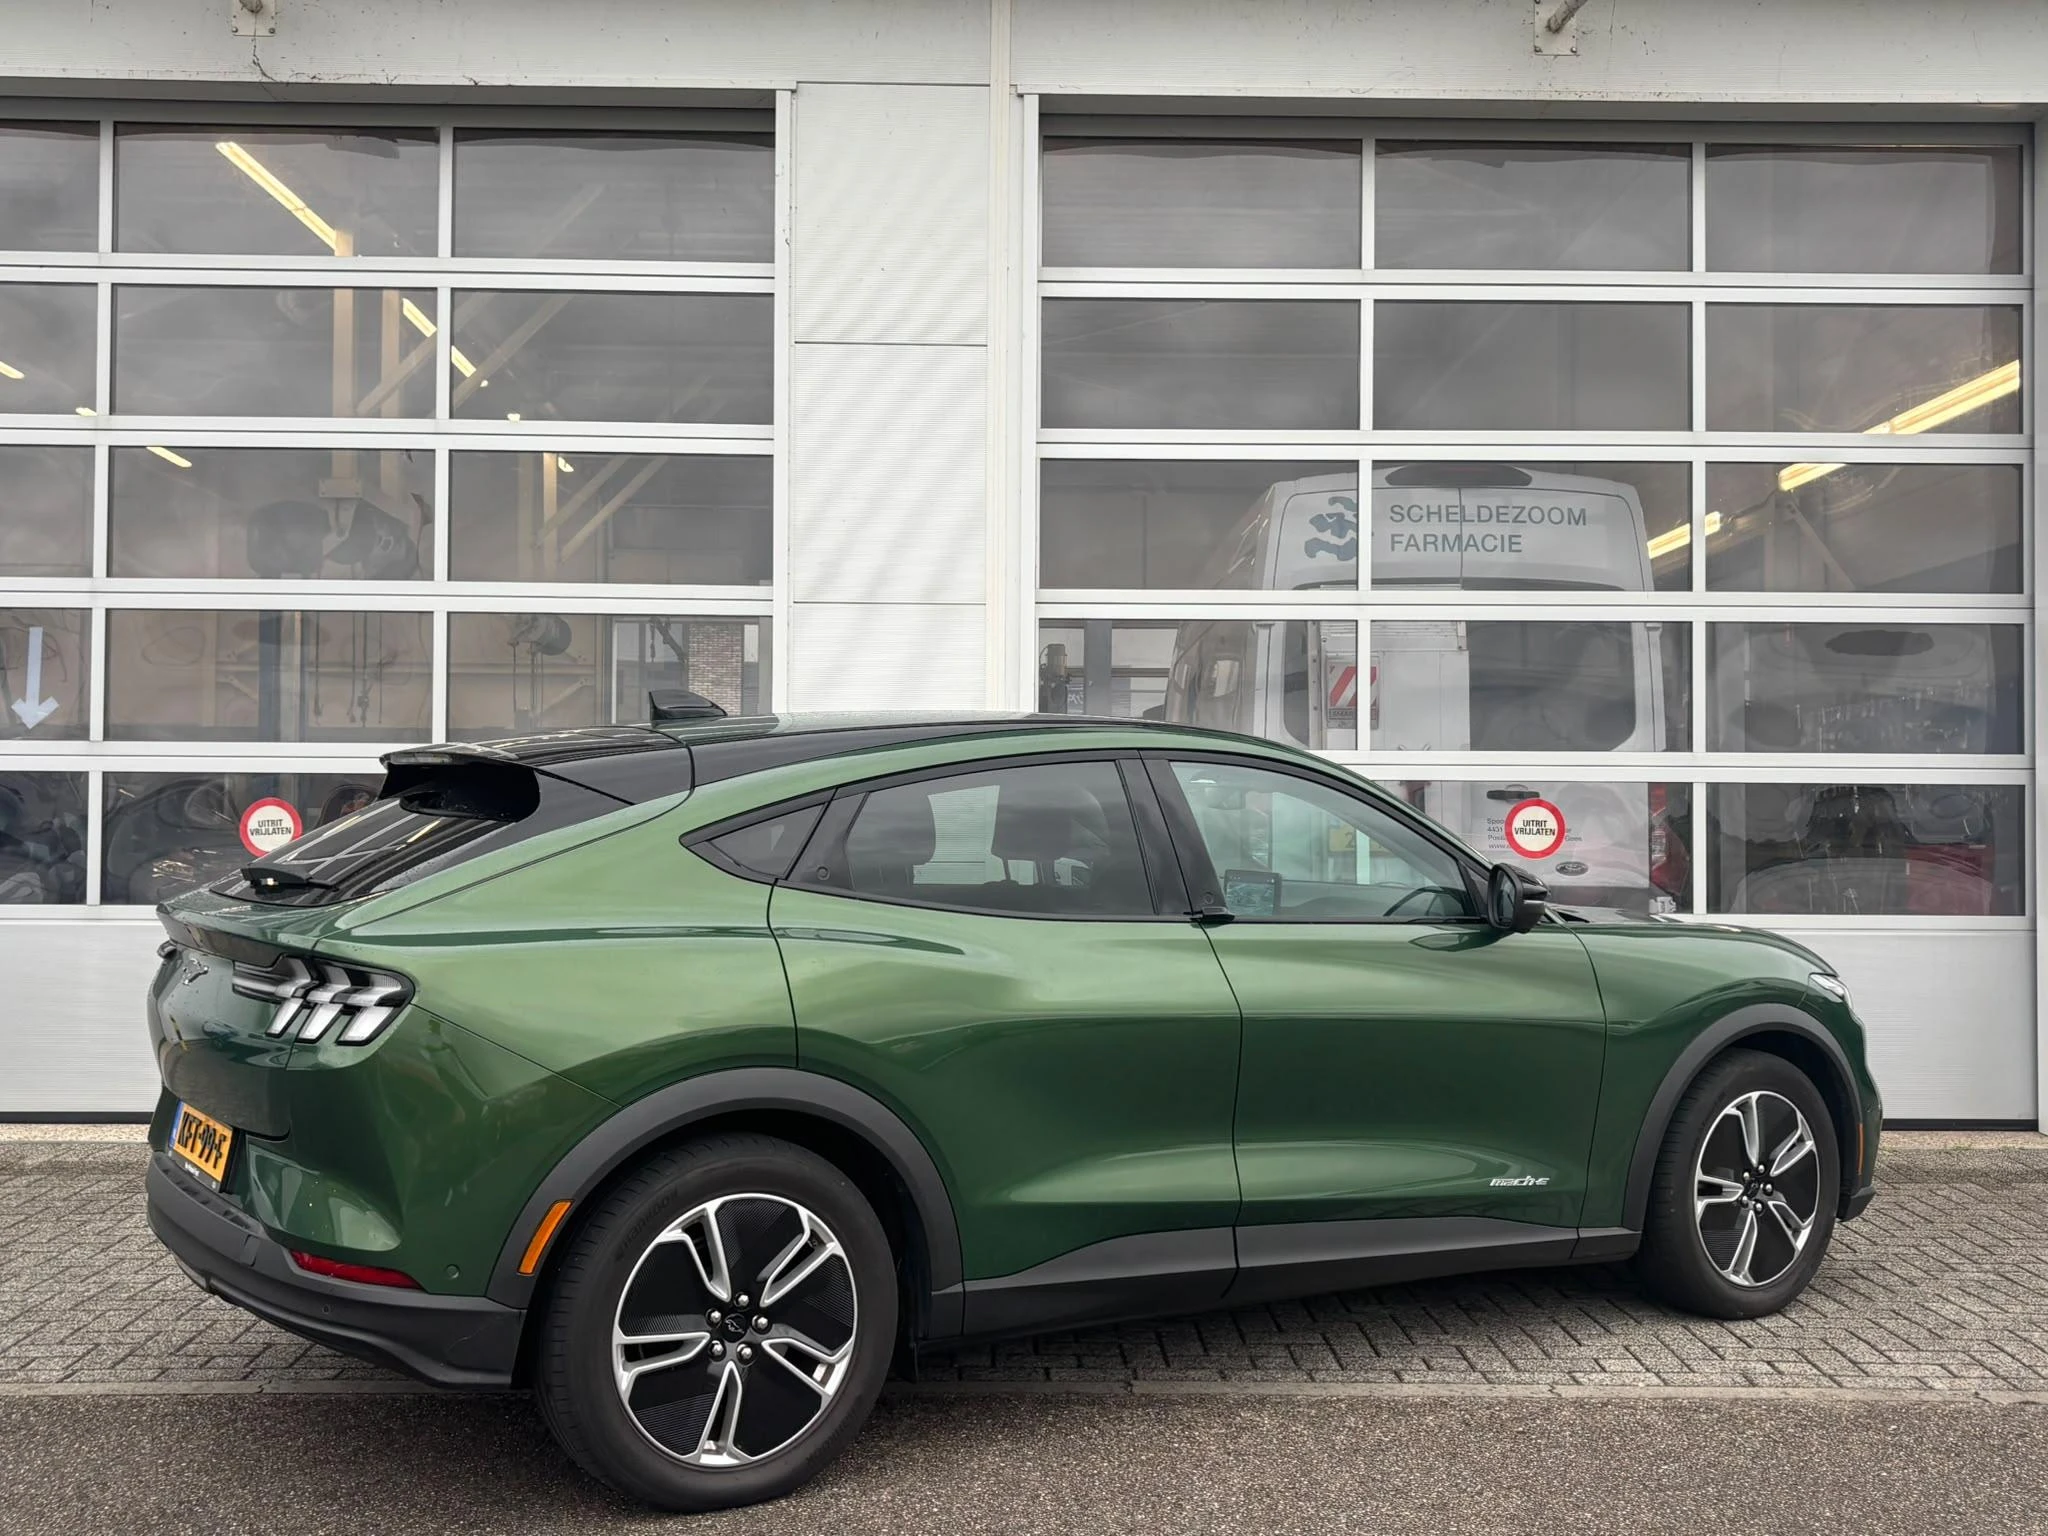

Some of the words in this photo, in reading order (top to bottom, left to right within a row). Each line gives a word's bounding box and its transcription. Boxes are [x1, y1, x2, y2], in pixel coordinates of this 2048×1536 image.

[1389, 504, 1587, 527] SCHELDEZOOM
[1390, 533, 1523, 553] FARMACIE
[257, 818, 284, 828] UITRIT
[1522, 819, 1549, 828] UITRIT
[249, 827, 292, 837] VRIJLATEN
[1514, 827, 1556, 837] VRIJLATEN
